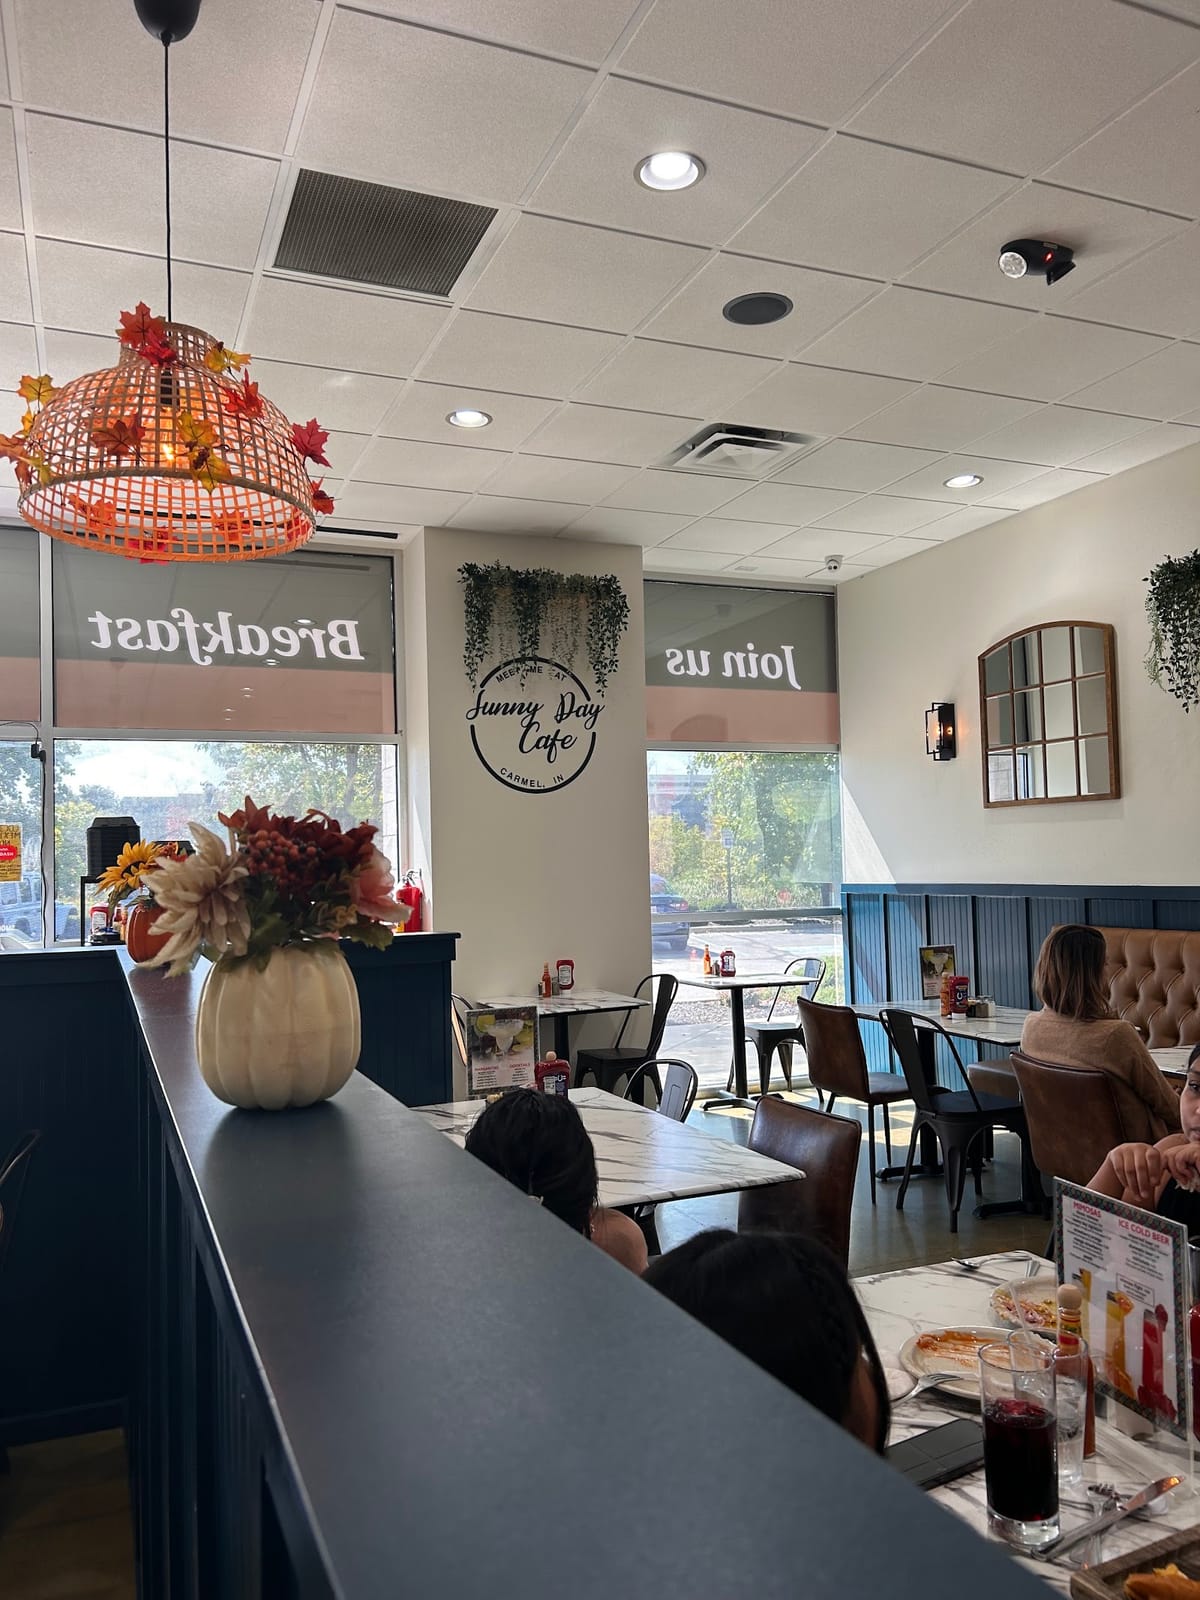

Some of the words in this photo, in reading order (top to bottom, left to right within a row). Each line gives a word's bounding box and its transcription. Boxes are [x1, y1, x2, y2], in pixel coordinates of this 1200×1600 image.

[530, 666, 543, 674] ME
[554, 672, 567, 682] AT
[466, 689, 544, 728] Sunny
[554, 691, 605, 730] Day
[519, 721, 577, 763] Cafe
[553, 774, 564, 785] IN
[1073, 1201, 1102, 1218] MIMOSAS
[1119, 1219, 1129, 1230] ICE
[1131, 1223, 1151, 1238] COLD
[1152, 1232, 1170, 1245] BEER
